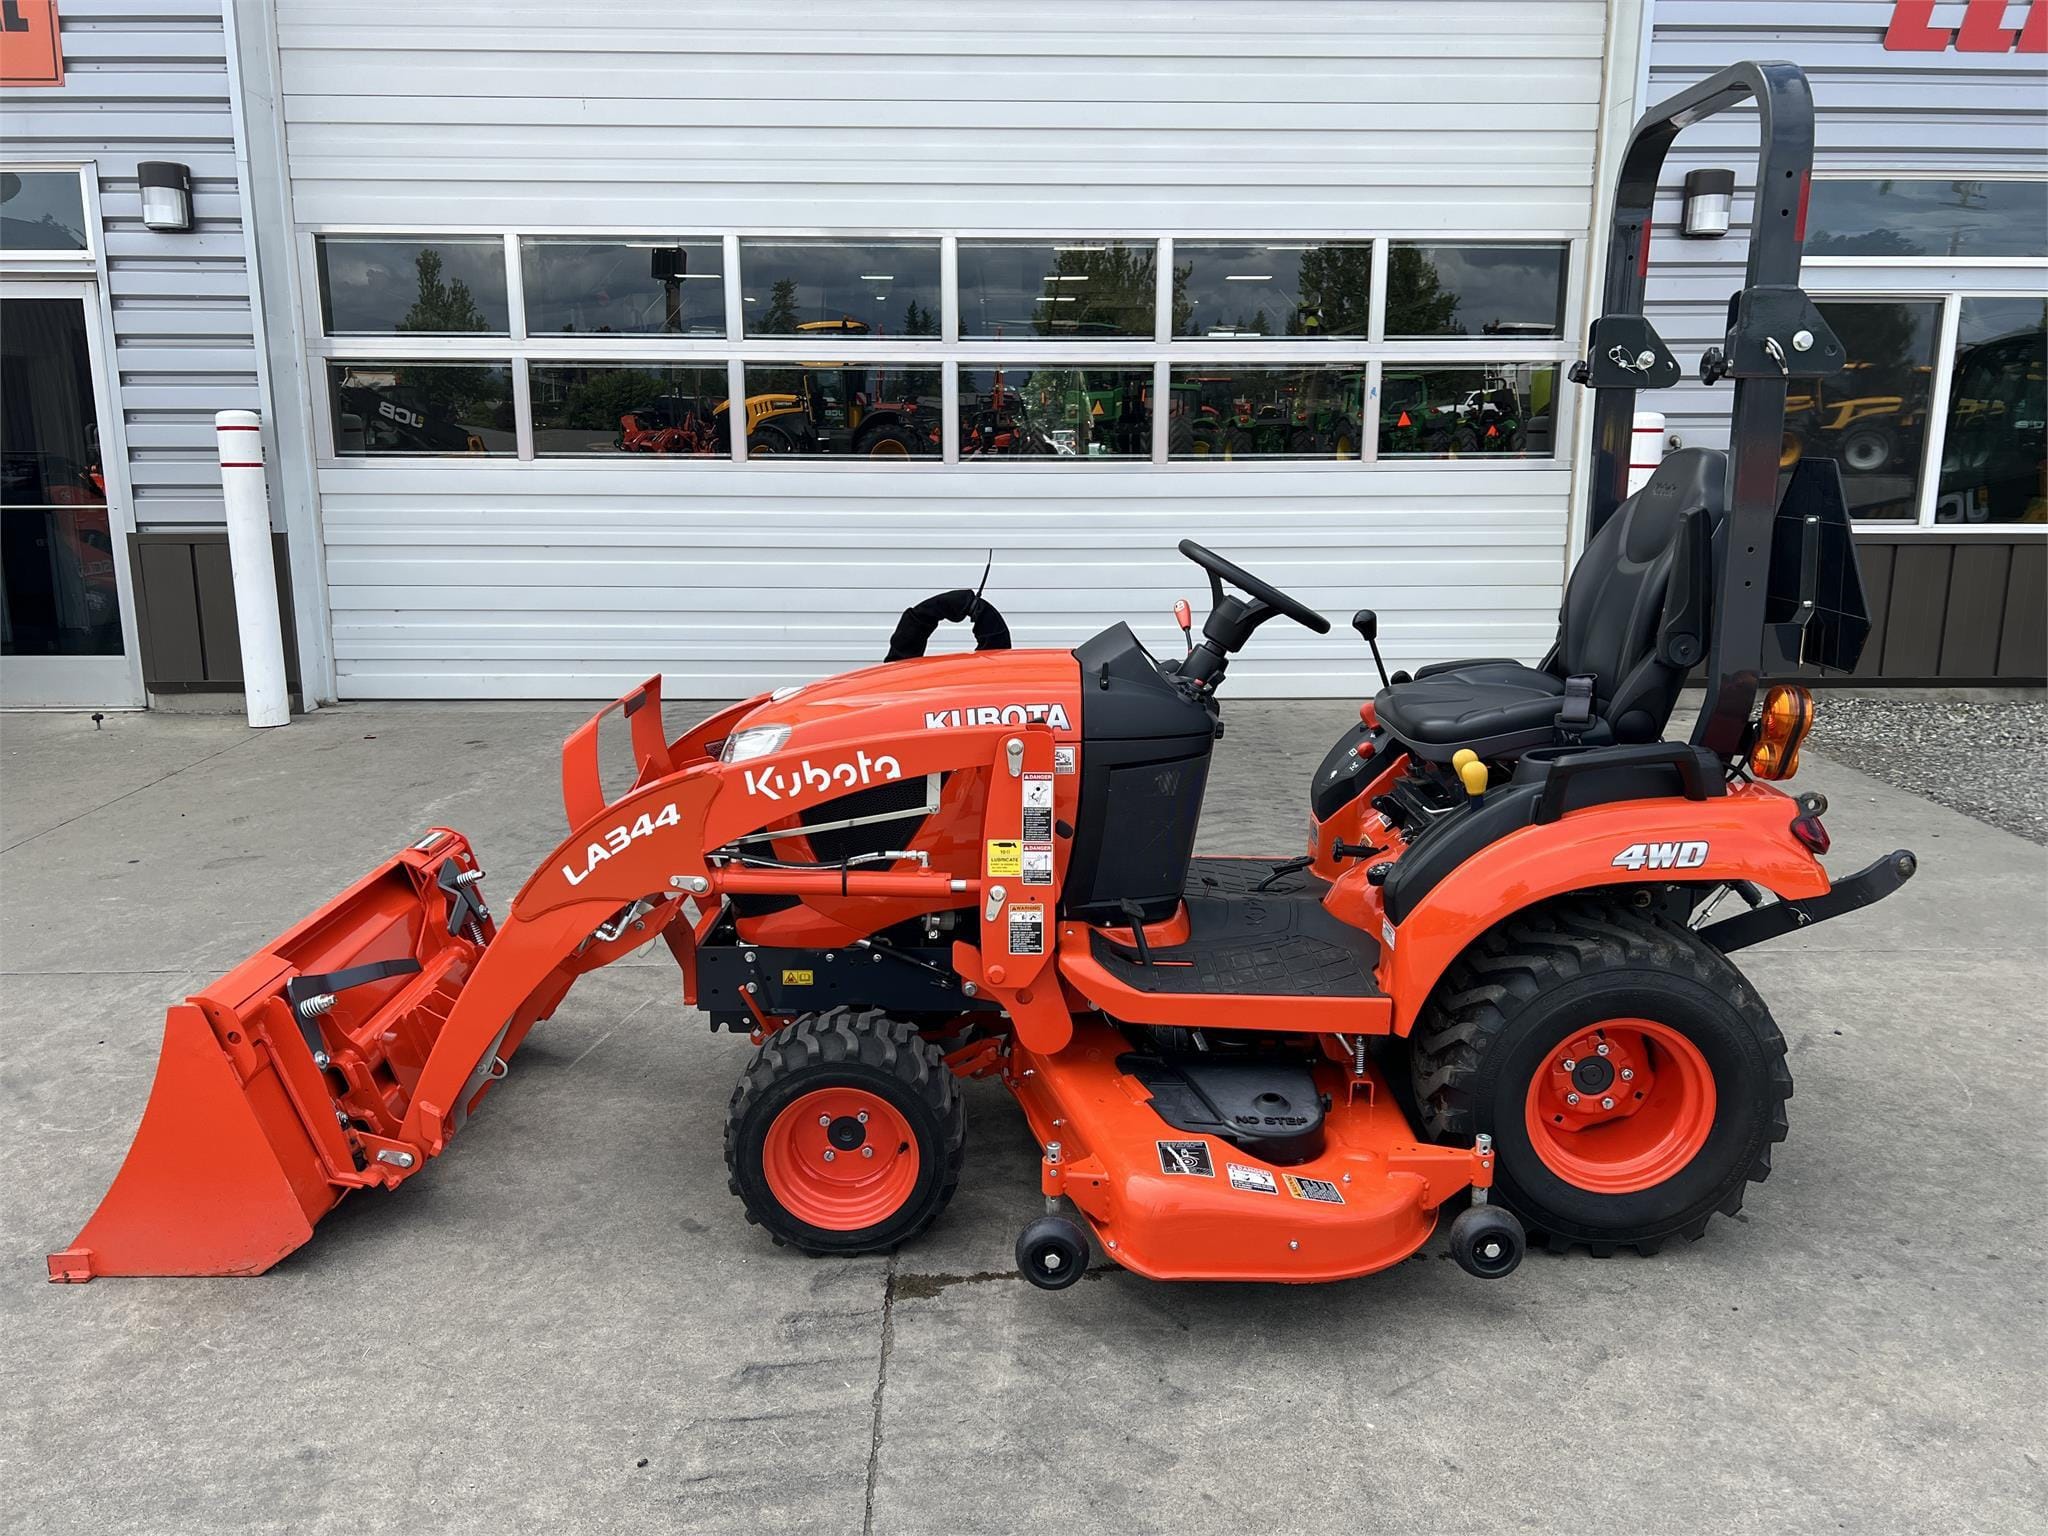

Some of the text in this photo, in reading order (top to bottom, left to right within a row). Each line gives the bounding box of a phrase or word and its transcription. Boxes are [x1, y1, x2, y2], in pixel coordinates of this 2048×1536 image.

[924, 703, 1072, 732] KUBOTA
[744, 750, 902, 801] Kubota
[561, 802, 681, 886] LA344
[1611, 840, 1710, 871] 4WD
[1235, 1115, 1308, 1126] NO STEP
